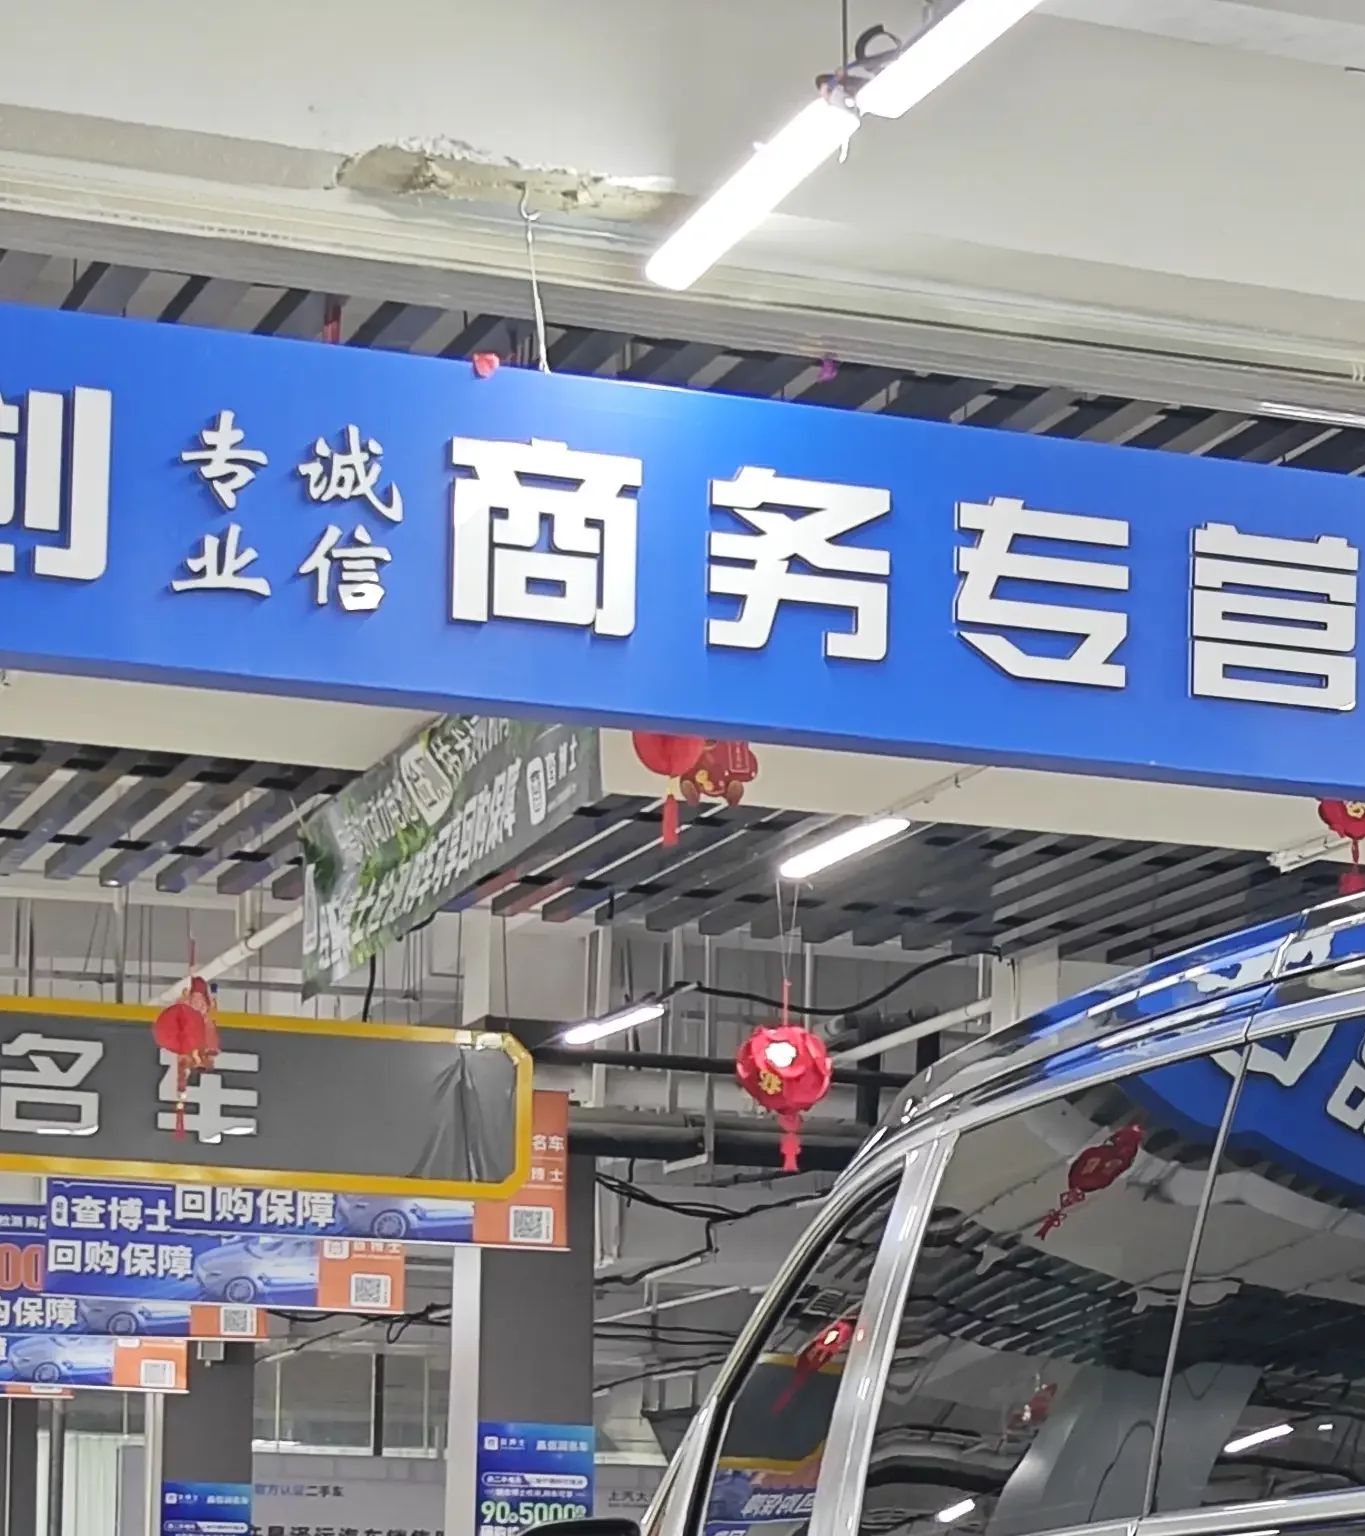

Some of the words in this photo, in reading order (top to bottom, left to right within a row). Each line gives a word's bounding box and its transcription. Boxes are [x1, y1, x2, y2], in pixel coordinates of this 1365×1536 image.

[449, 437, 1360, 713] 商务专营
[0, 1033, 259, 1144] 名车
[70, 1195, 172, 1232] 查博士
[175, 1184, 336, 1228] 回购保障
[48, 1239, 193, 1278] 回购保障
